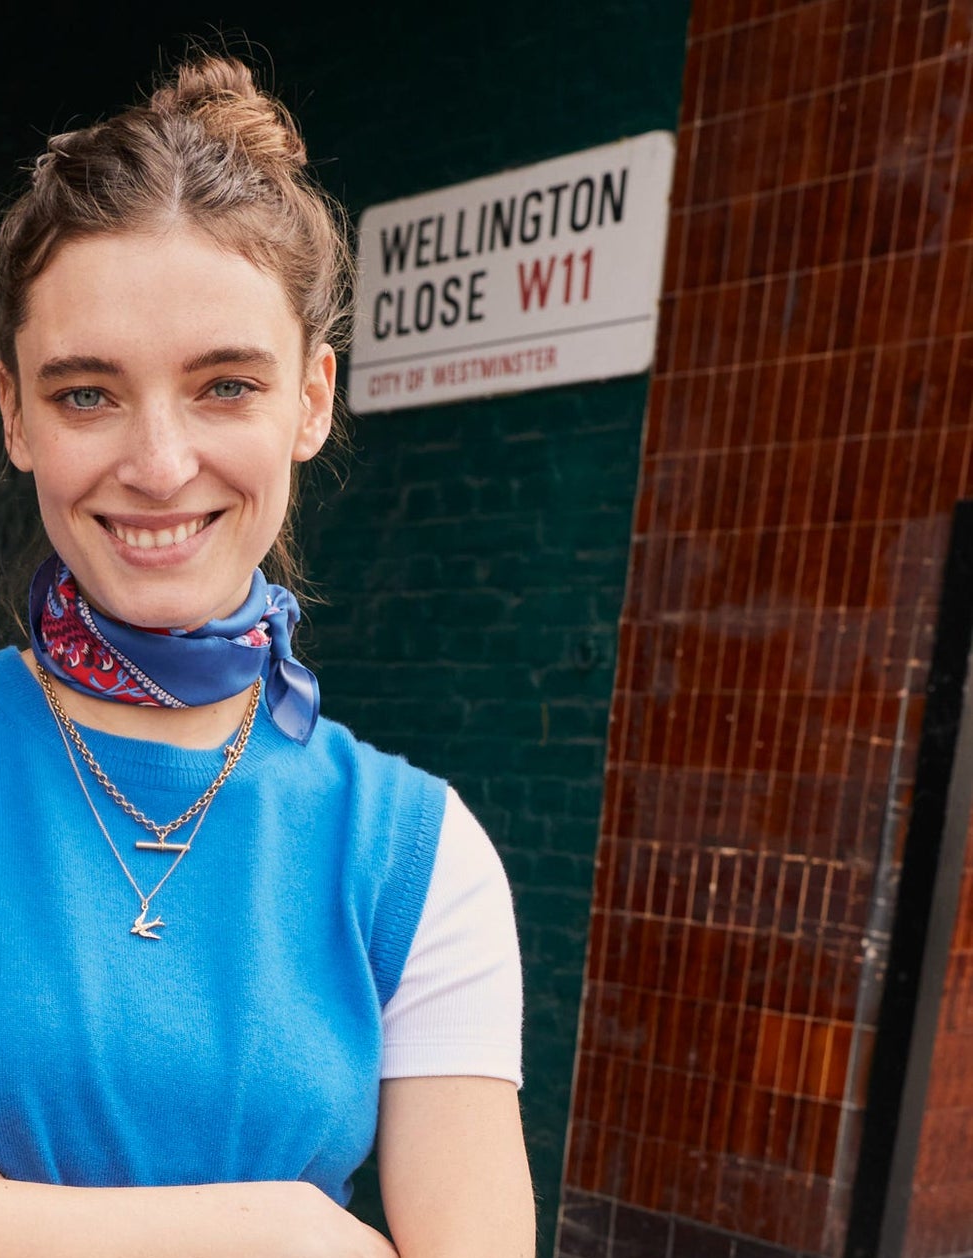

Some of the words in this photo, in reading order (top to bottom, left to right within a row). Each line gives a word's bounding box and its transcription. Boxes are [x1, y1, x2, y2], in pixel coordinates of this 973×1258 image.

[381, 168, 628, 276] WELLINGTON
[373, 270, 487, 341] CLOSE
[517, 247, 594, 313] W11
[368, 371, 402, 397] CITY
[406, 366, 424, 392] OF
[431, 345, 557, 386] WESTMINSTER
